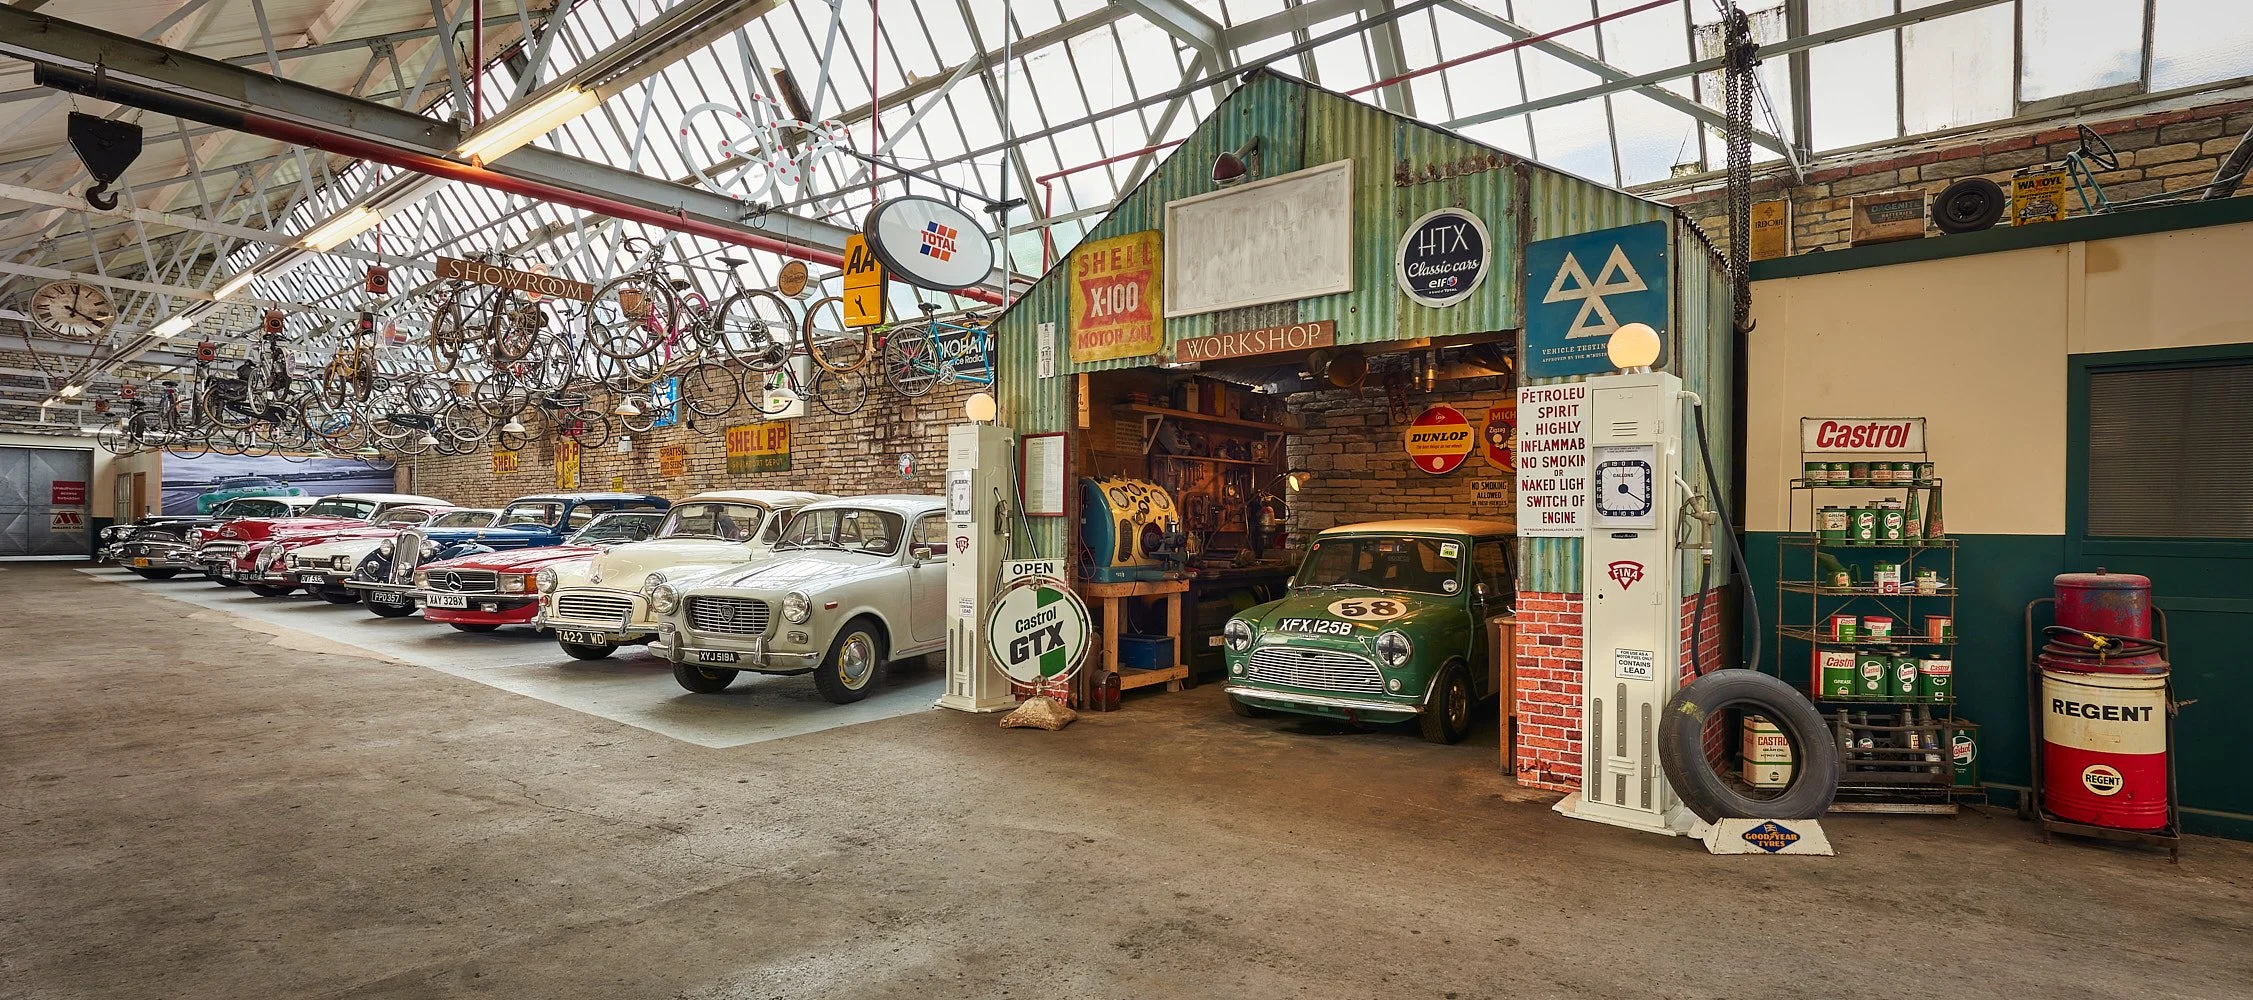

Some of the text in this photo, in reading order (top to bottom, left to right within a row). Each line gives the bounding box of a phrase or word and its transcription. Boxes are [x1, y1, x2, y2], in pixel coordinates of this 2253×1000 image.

[2017, 176, 2062, 190] WAXOYL
[921, 229, 957, 253] TOTAL
[1418, 222, 1470, 257] HTX
[846, 245, 875, 275] AA
[1078, 240, 1153, 278] SHELL
[1408, 259, 1480, 278] Classic cars
[449, 260, 583, 300] SHOWROOM
[1428, 277, 1447, 289] elf
[1090, 281, 1139, 318] X-100
[1078, 329, 1124, 351] MOTOR
[1186, 322, 1321, 360] WORKSHOP
[926, 335, 995, 361] YOKOHAM
[1542, 342, 1606, 355] VEHICLE TESTIN
[1521, 387, 1585, 404] PETROLEU
[1491, 410, 1516, 421] MICH
[1538, 404, 1579, 419] SPIRIT
[1536, 421, 1581, 435] HIGHLY
[1817, 420, 1912, 448] Castrol
[729, 427, 786, 453] SHELL BP
[1411, 431, 1469, 443] DUNLOP
[1521, 437, 1585, 452] INFLAMMAB
[493, 454, 518, 472] SHELL
[765, 458, 783, 467] DEPOT
[1522, 455, 1585, 468] NO SMOKIN
[1472, 481, 1507, 490] NO SMOKING
[1522, 477, 1585, 491] NAKED LIGH
[1527, 494, 1585, 507] SWITCH OF
[1542, 512, 1576, 524] ENGINE
[1013, 562, 1054, 575] OPEN
[1613, 568, 1638, 579] FINA
[429, 595, 464, 606] XAY 328X
[1341, 601, 1399, 617] 58
[1015, 606, 1057, 634] Castrol
[1279, 619, 1353, 636] XFX 125B
[557, 631, 605, 645] 7422 WD
[1010, 620, 1066, 666] GTX
[700, 651, 735, 662] XYJ 519A
[1864, 665, 1880, 676] Castrol
[1900, 668, 1914, 677] Castrol
[1930, 664, 1950, 672] Castrol
[2052, 698, 2153, 721] REGENT
[1758, 736, 1789, 746] CASTRO
[2085, 774, 2121, 786] REGENT
